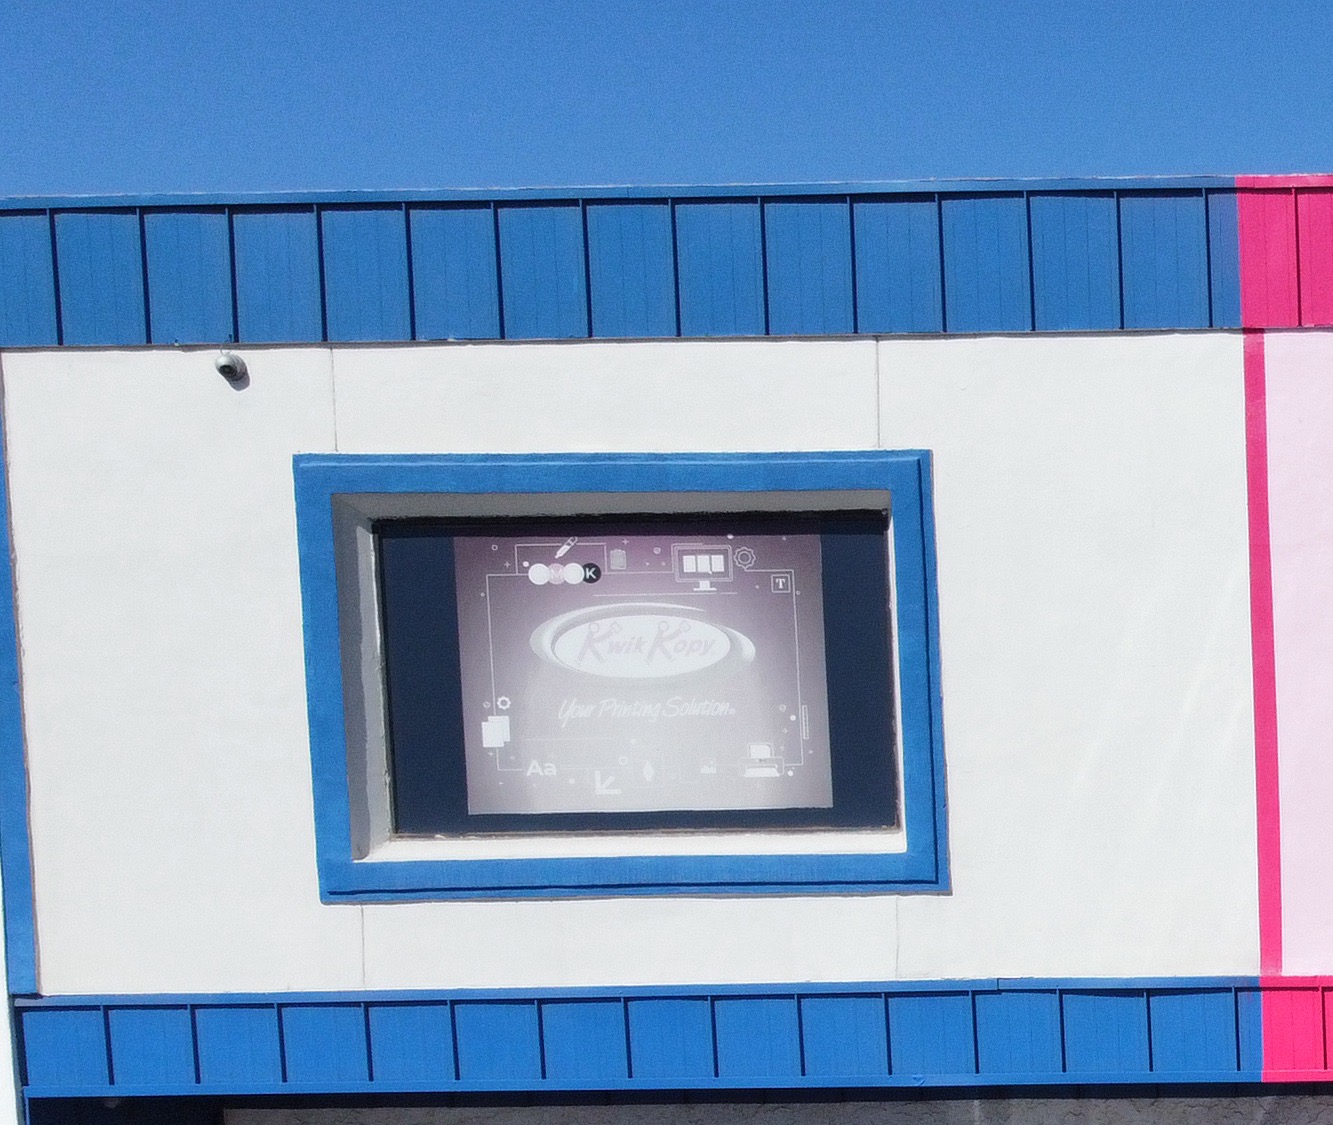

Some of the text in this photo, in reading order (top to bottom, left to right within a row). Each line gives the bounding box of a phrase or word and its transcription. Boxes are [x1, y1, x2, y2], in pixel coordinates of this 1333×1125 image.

[585, 567, 598, 580] K
[775, 577, 786, 589] T
[558, 697, 729, 729] Your Printing Solution
[526, 760, 557, 777] Aa
